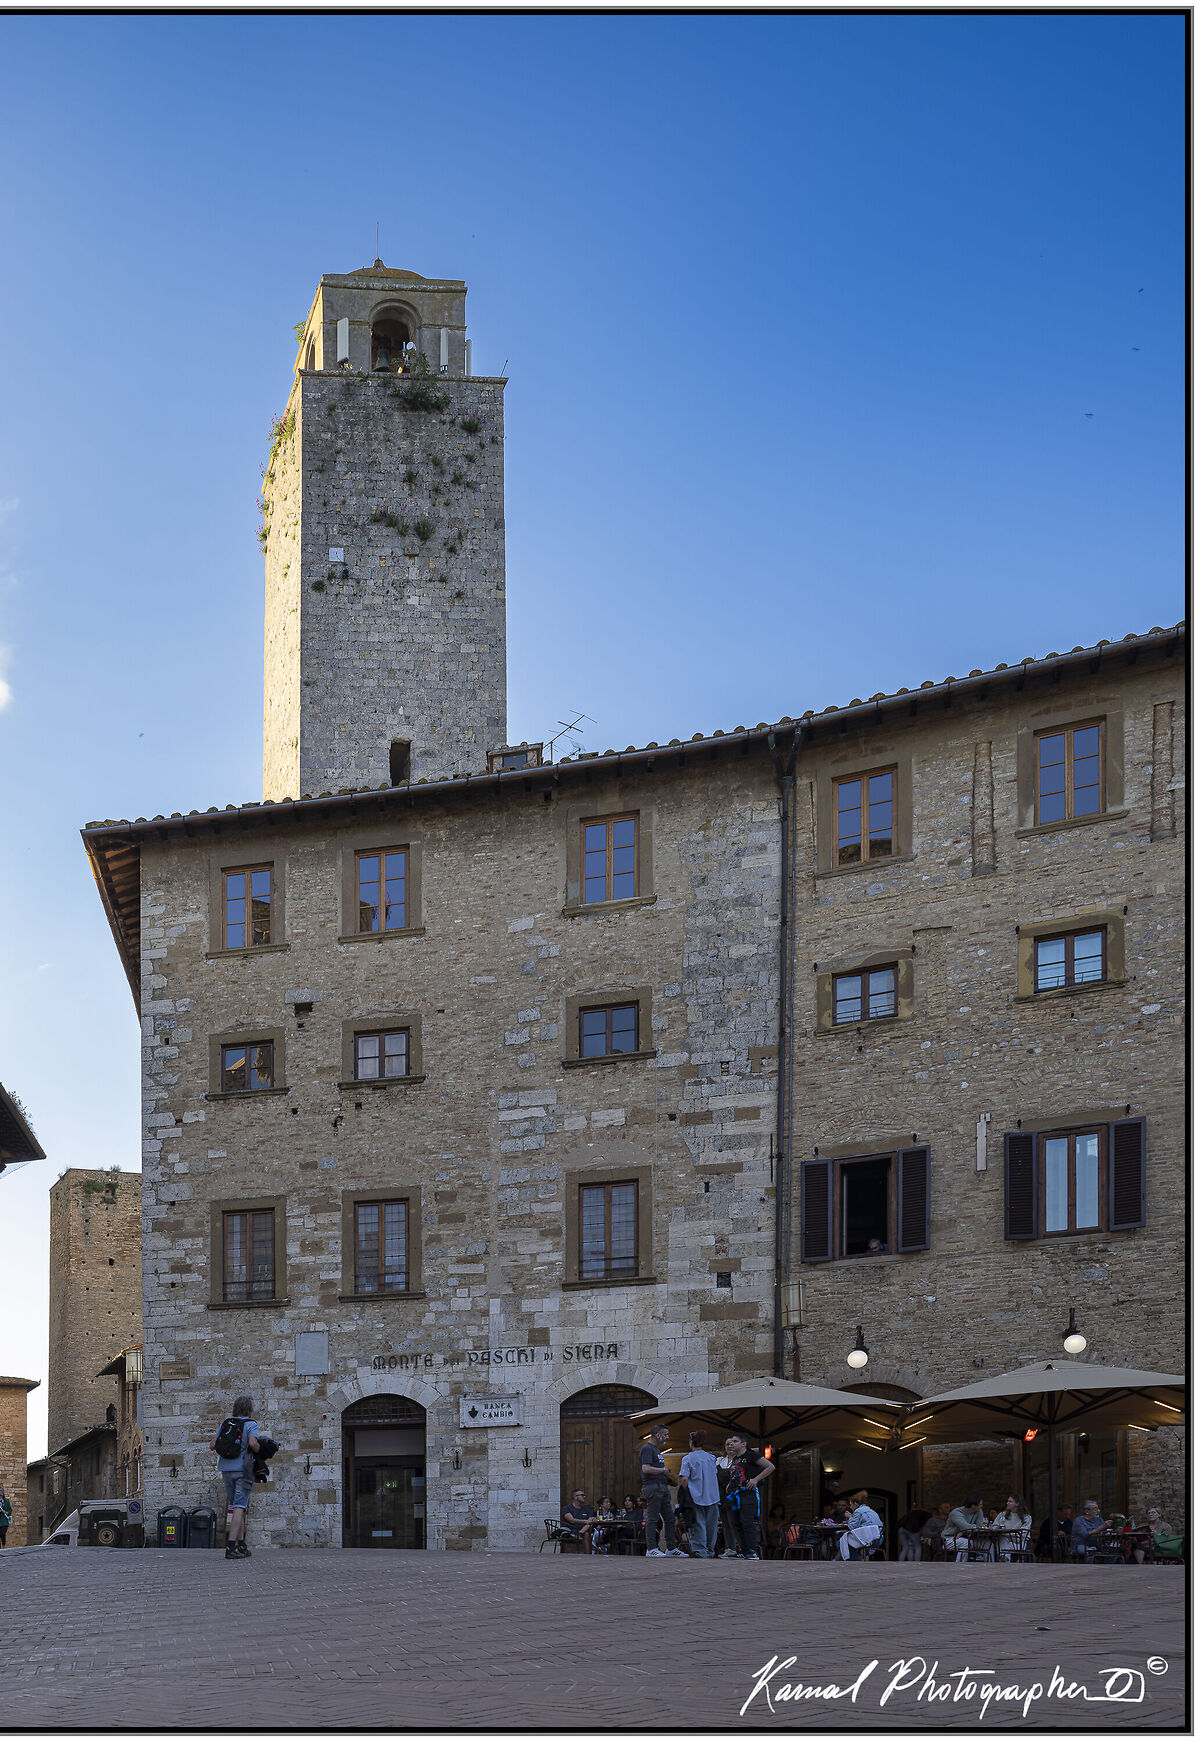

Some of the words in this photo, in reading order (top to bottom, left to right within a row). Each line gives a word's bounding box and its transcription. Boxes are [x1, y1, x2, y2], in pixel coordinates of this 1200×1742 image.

[373, 1353, 434, 1370] MONTE
[467, 1347, 535, 1365] PASCHI
[543, 1352, 554, 1361] DI
[563, 1343, 619, 1361] SIENA
[484, 1402, 512, 1410] BANCA
[482, 1410, 514, 1419] CAMBIO
